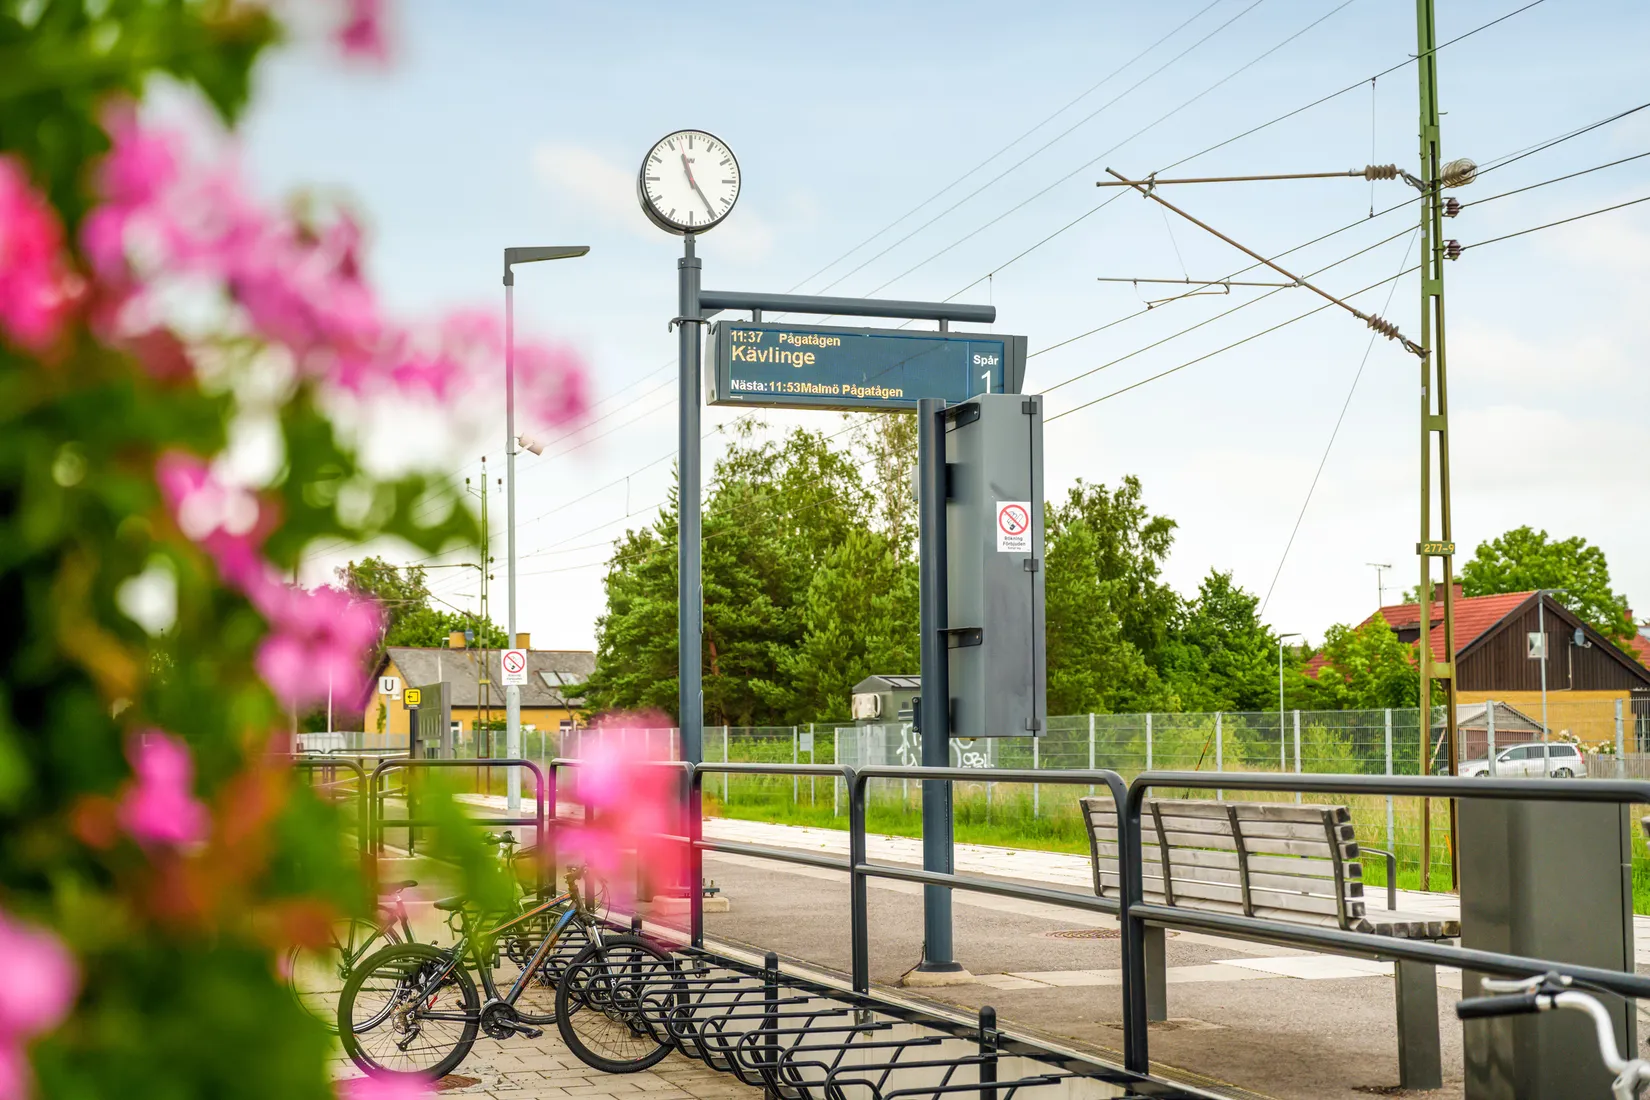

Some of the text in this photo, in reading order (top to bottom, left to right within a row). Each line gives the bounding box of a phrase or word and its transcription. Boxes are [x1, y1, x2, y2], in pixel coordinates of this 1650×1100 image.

[731, 330, 841, 348] 11:37 Pågatågen
[731, 344, 816, 368] Kävlinge
[973, 354, 999, 367] Spår
[731, 379, 768, 392] Nästa:
[842, 383, 903, 399] Pågatågen
[981, 370, 991, 394] 1
[1423, 543, 1455, 553] 277-9
[384, 679, 394, 692] U
